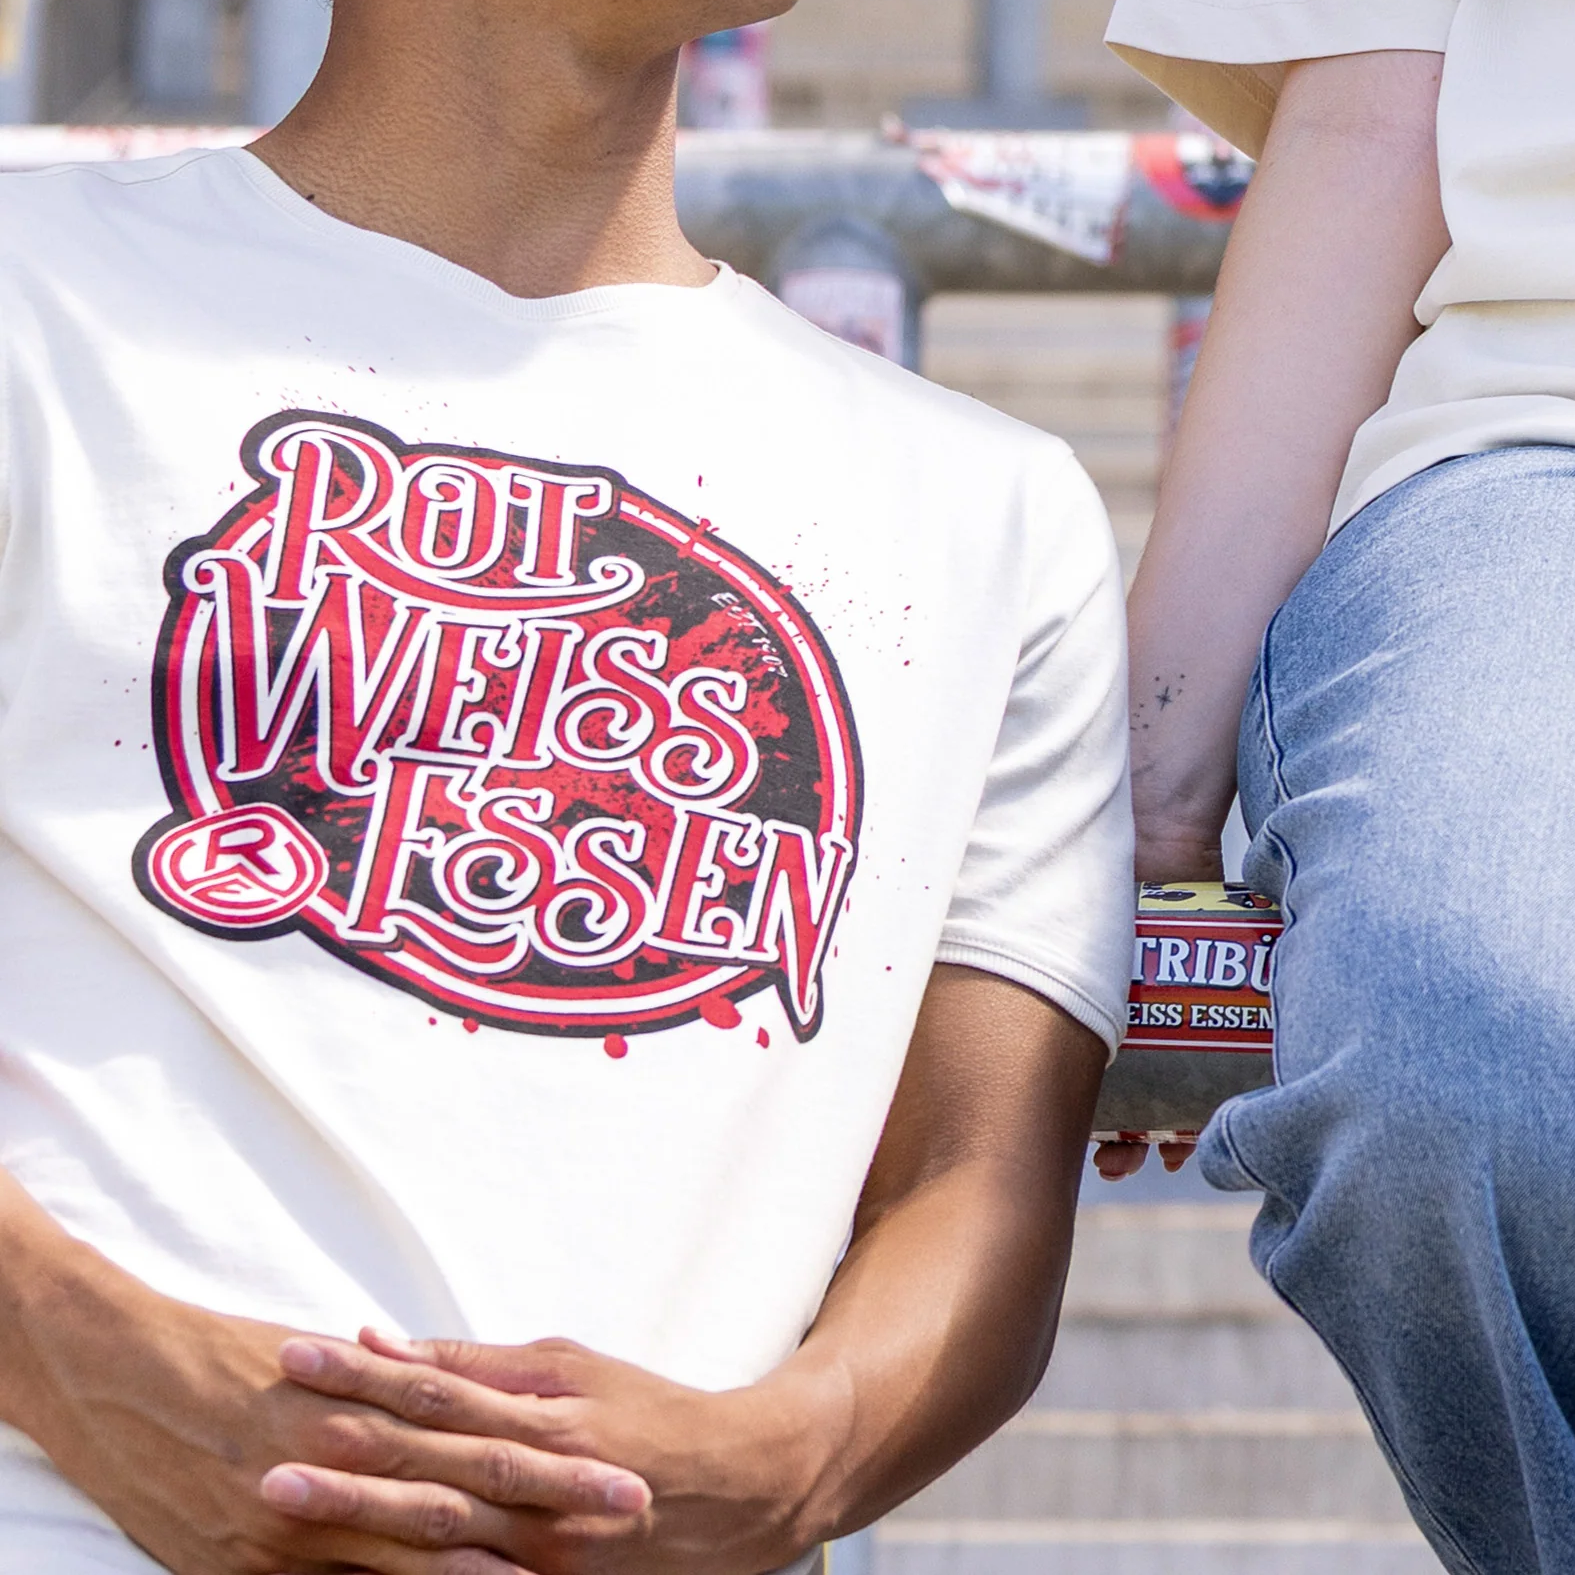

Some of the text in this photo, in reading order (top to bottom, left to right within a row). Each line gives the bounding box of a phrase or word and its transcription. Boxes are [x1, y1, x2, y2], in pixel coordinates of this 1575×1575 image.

[259, 420, 644, 618] ROT
[185, 549, 760, 813] WEISS
[338, 757, 854, 1027] ESSEN
